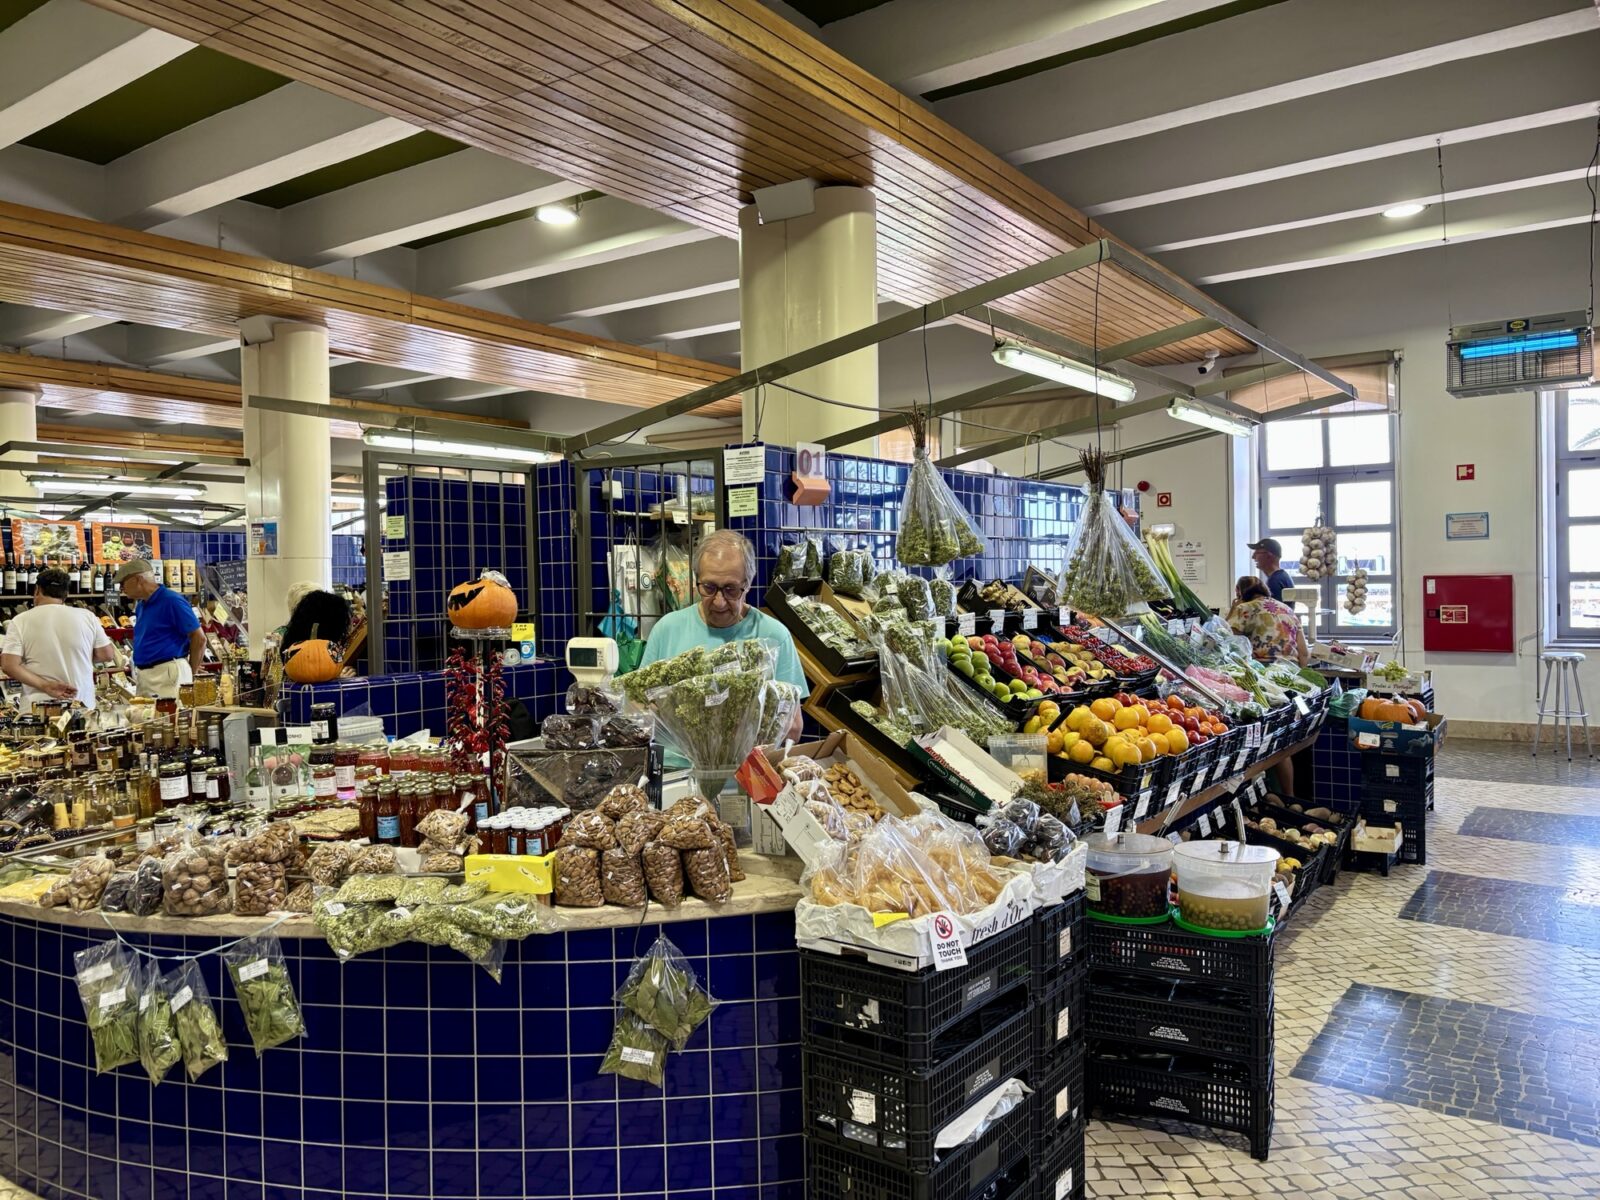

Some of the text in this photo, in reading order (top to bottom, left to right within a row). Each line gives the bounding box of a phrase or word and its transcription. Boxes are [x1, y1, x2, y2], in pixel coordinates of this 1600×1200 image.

[799, 449, 823, 475] 01
[971, 916, 998, 945] fresh
[938, 947, 962, 958] TOUCH
[946, 940, 959, 948] NOT
